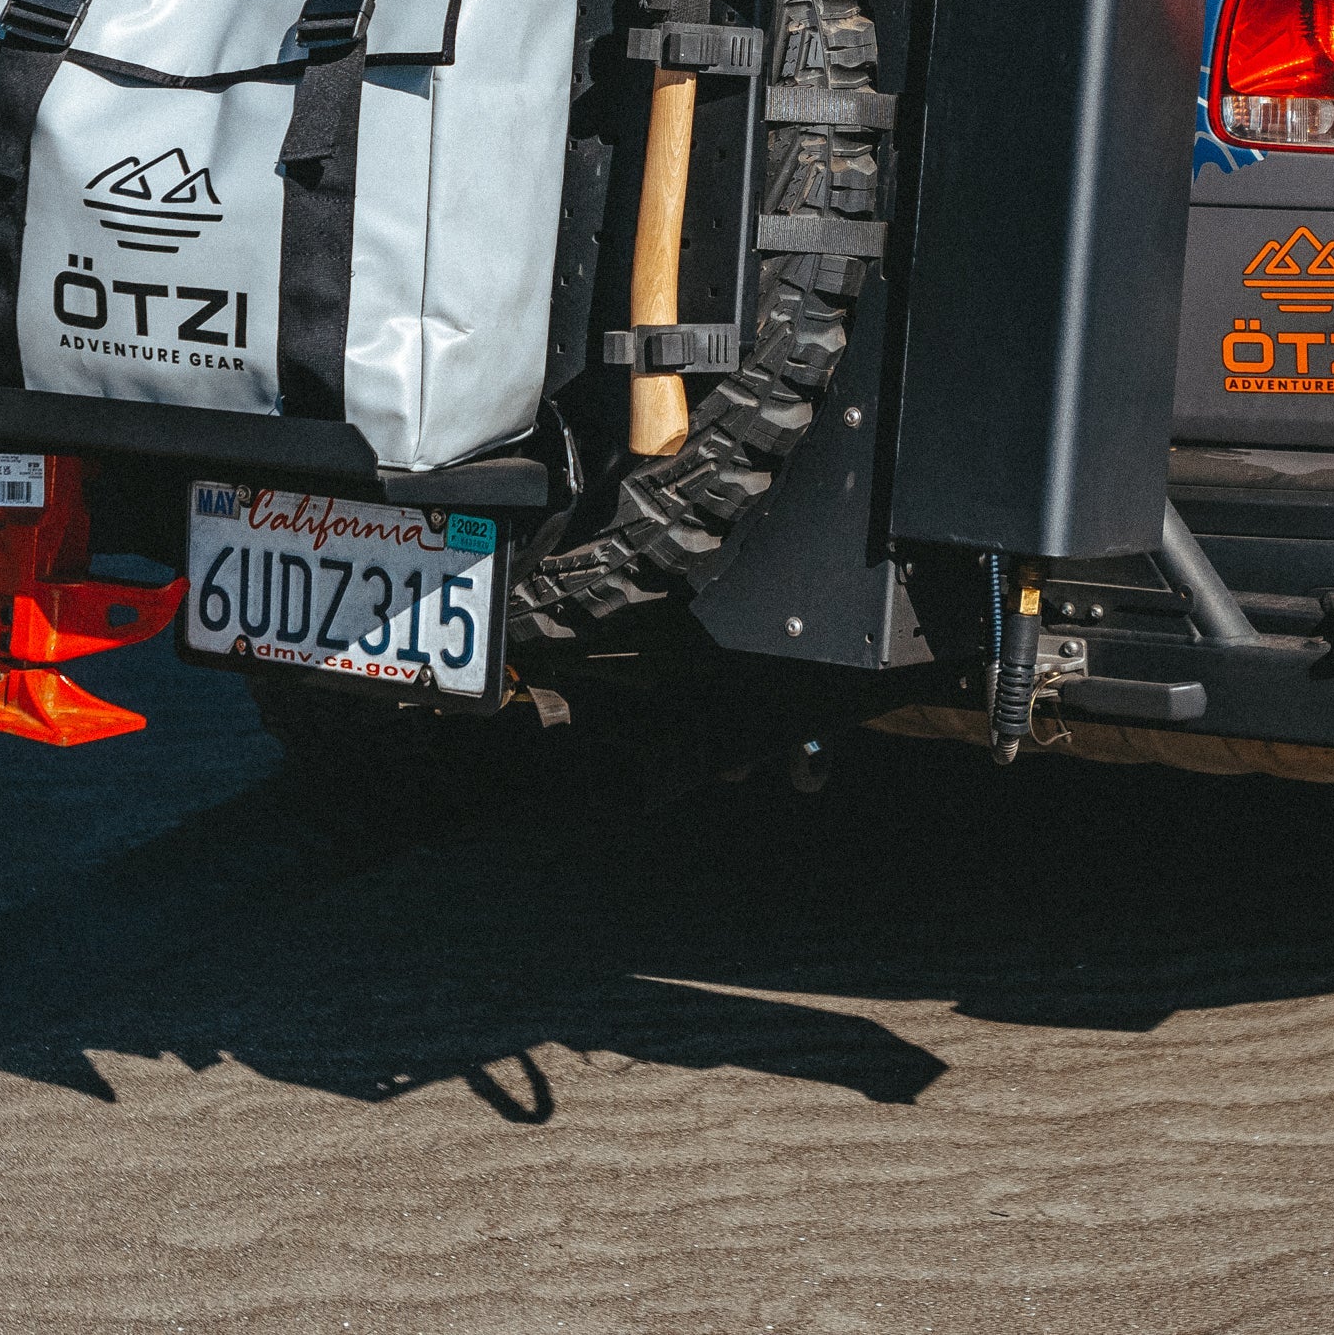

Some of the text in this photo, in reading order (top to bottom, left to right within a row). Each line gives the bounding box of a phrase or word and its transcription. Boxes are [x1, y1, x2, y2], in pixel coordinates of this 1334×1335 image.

[54, 253, 248, 349] ÖTZI
[60, 334, 245, 371] ADVENTURE GEAR
[1229, 379, 1334, 392] ADVENTURE
[198, 488, 236, 514] MAY
[248, 489, 444, 551] California
[456, 518, 488, 538] 2022
[199, 546, 475, 669] 6UDZ315
[256, 644, 417, 680] dmv.ca.gov
